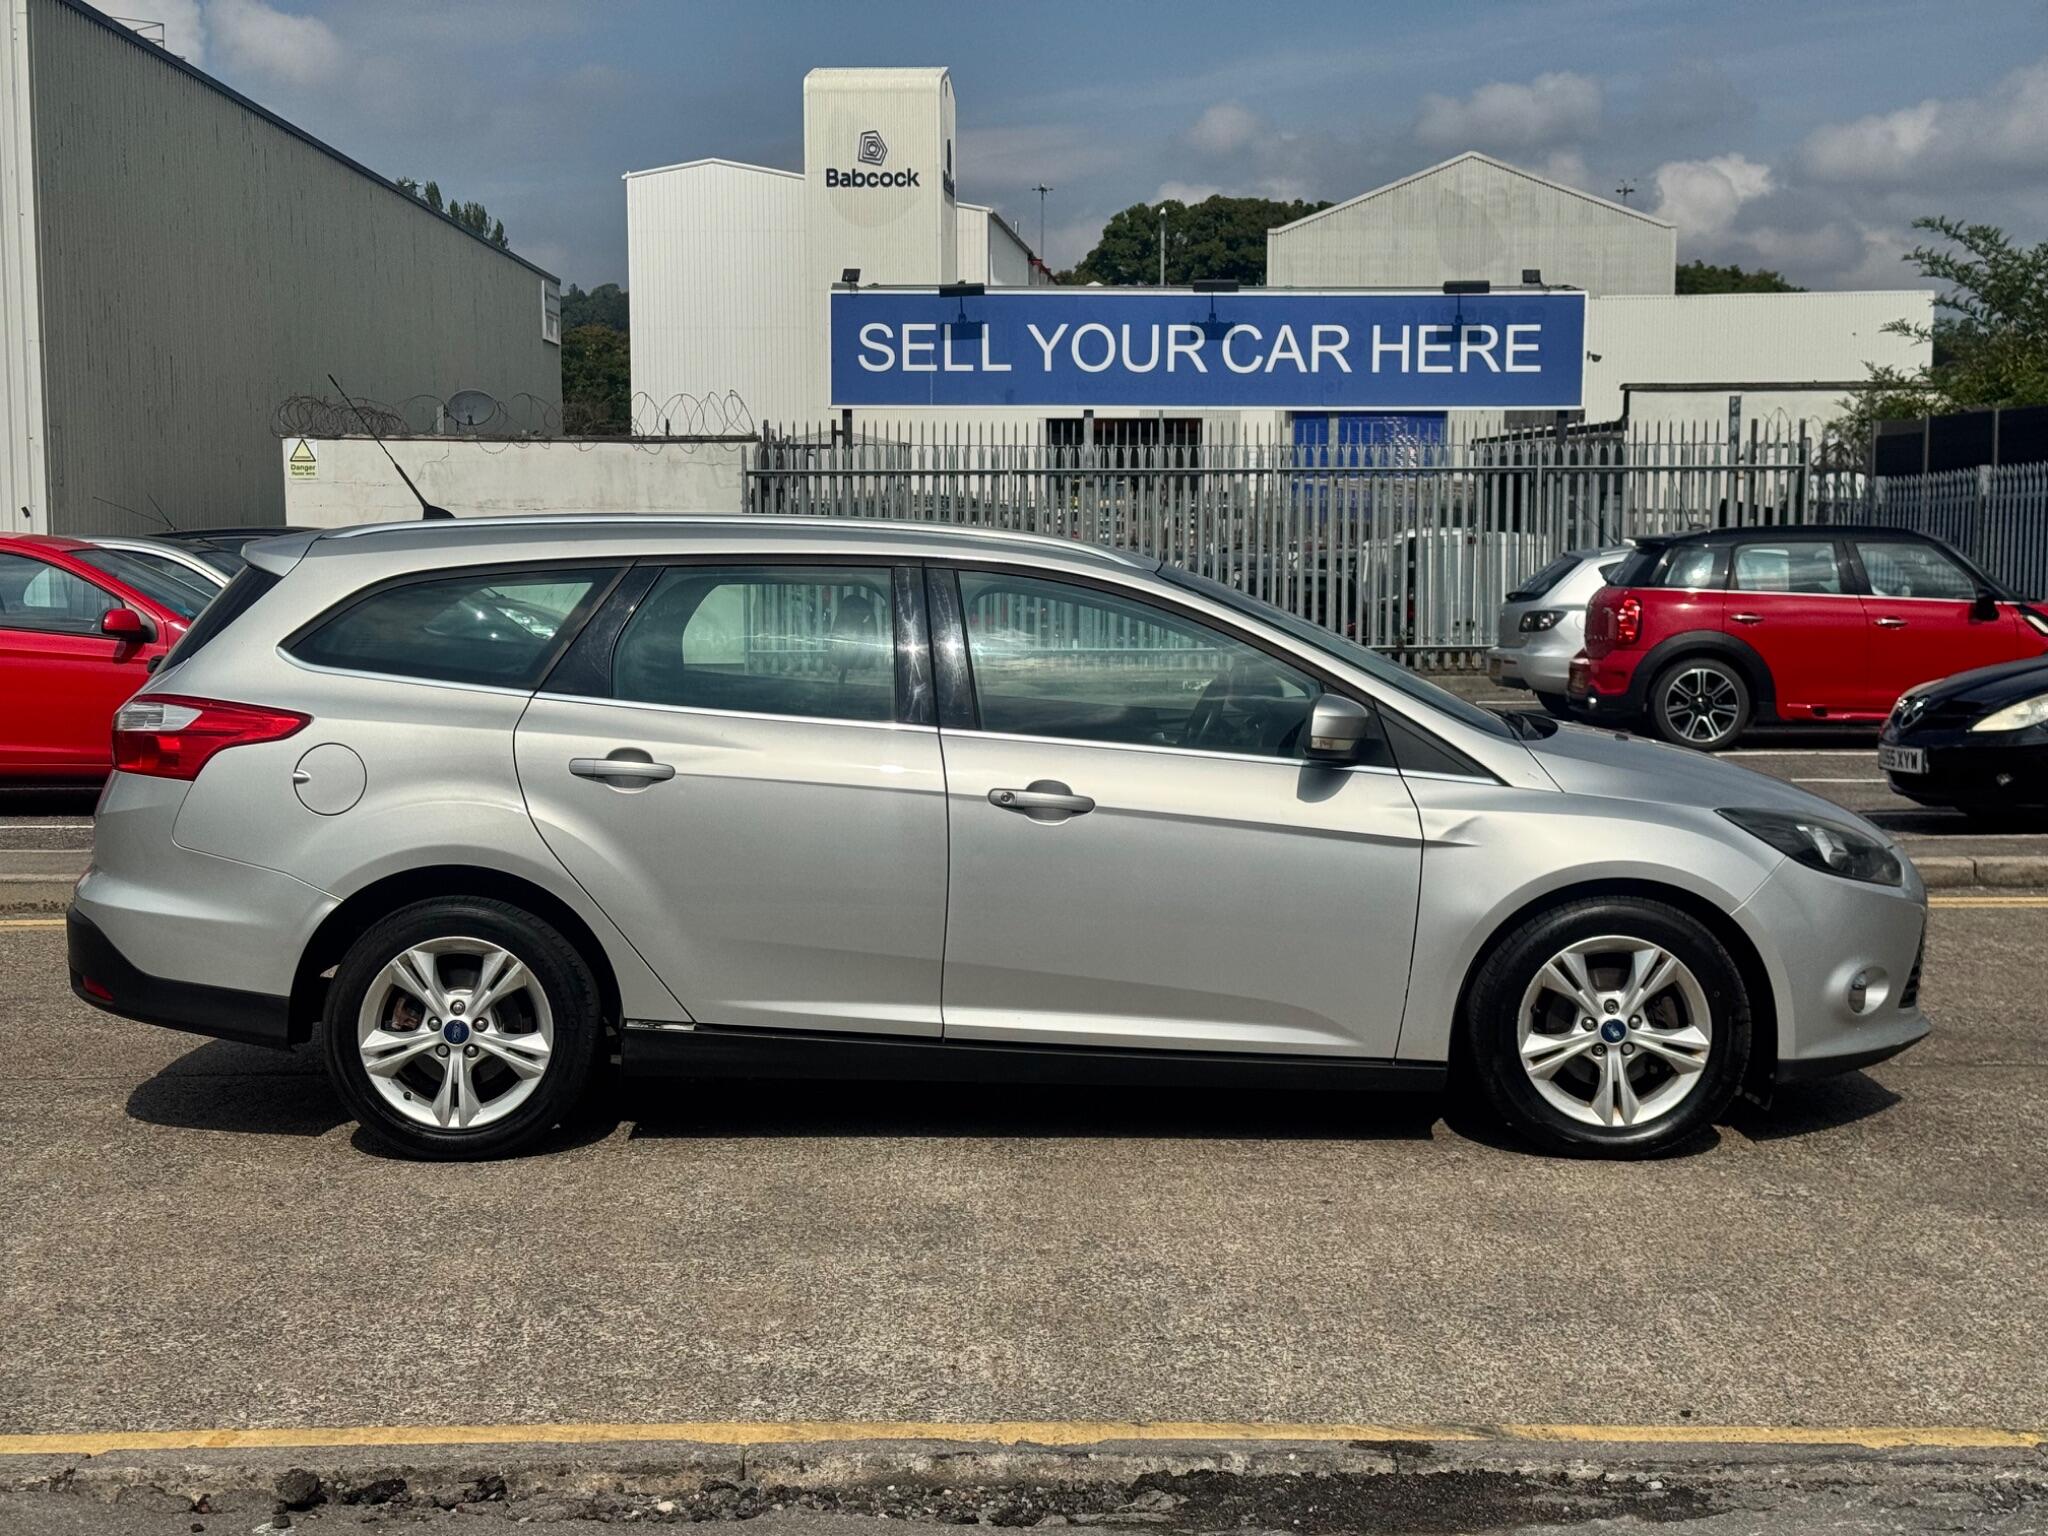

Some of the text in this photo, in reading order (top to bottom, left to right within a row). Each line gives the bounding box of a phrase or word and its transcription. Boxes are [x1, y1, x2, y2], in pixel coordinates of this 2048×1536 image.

[826, 168, 920, 188] Babcock
[857, 322, 1542, 374] SELL YOUR CAR HERE
